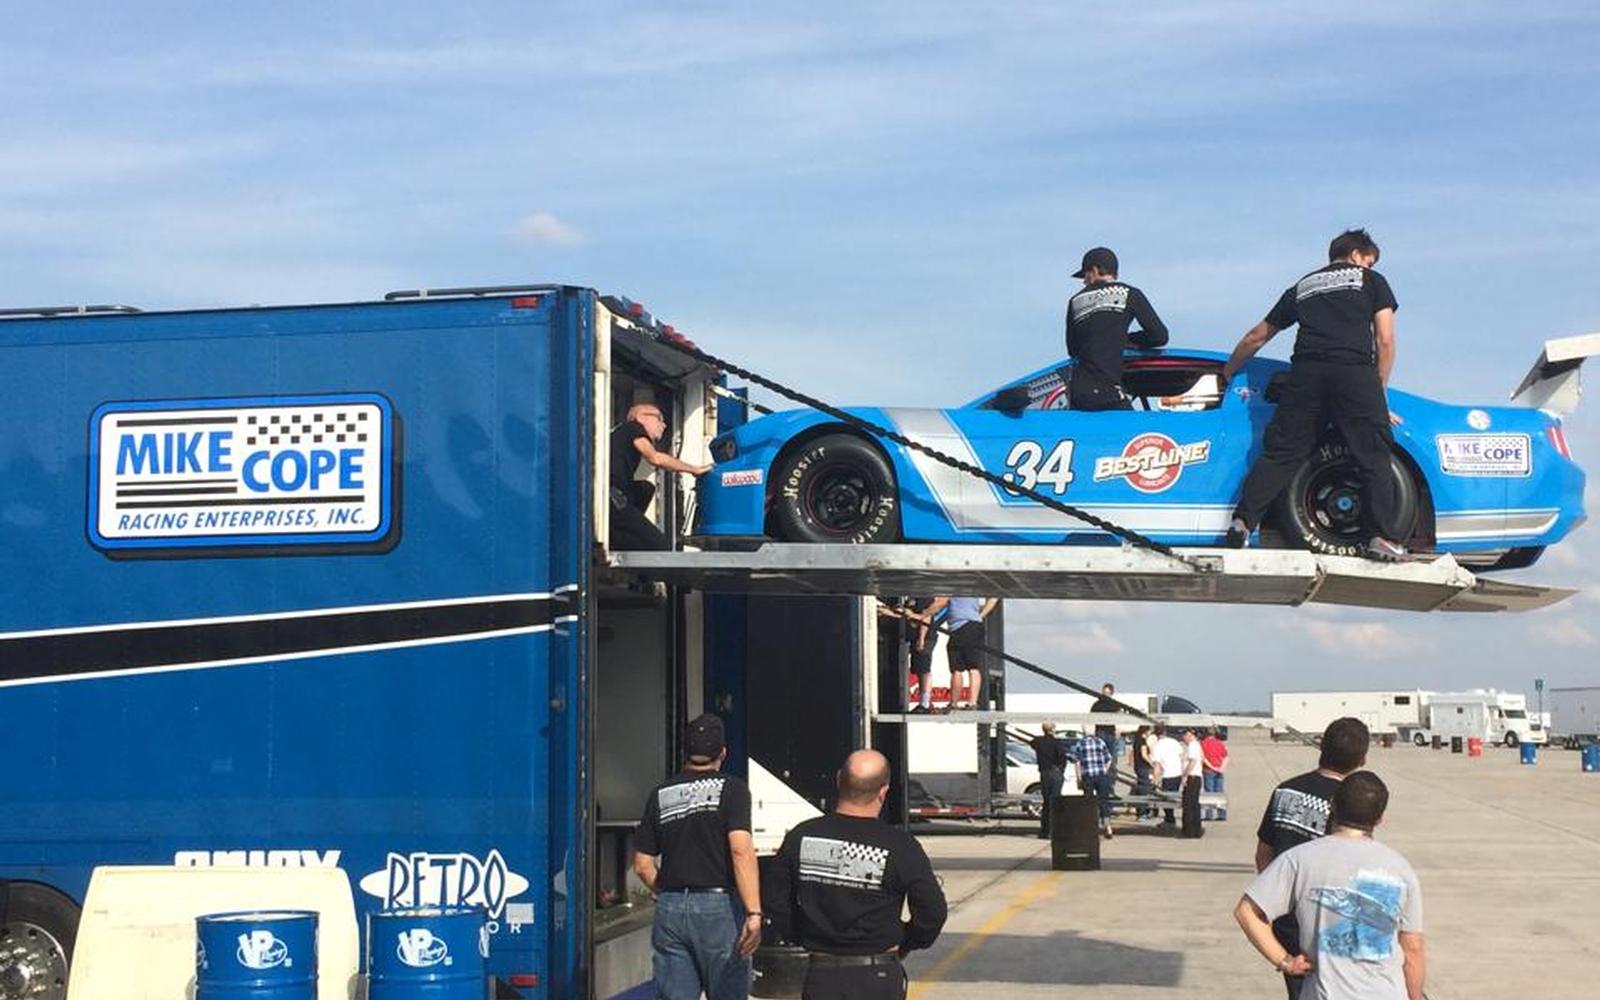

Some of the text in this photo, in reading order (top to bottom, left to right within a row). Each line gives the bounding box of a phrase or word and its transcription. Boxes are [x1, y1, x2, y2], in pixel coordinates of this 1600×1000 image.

[116, 431, 233, 475] MIKE
[242, 448, 365, 493] COPE
[1003, 439, 1075, 496] 34
[1094, 441, 1210, 481] BESTLINE
[1484, 448, 1523, 460] COPE
[118, 507, 365, 530] RACING ENTERPRISES, INC.
[386, 850, 507, 916] RETRO
